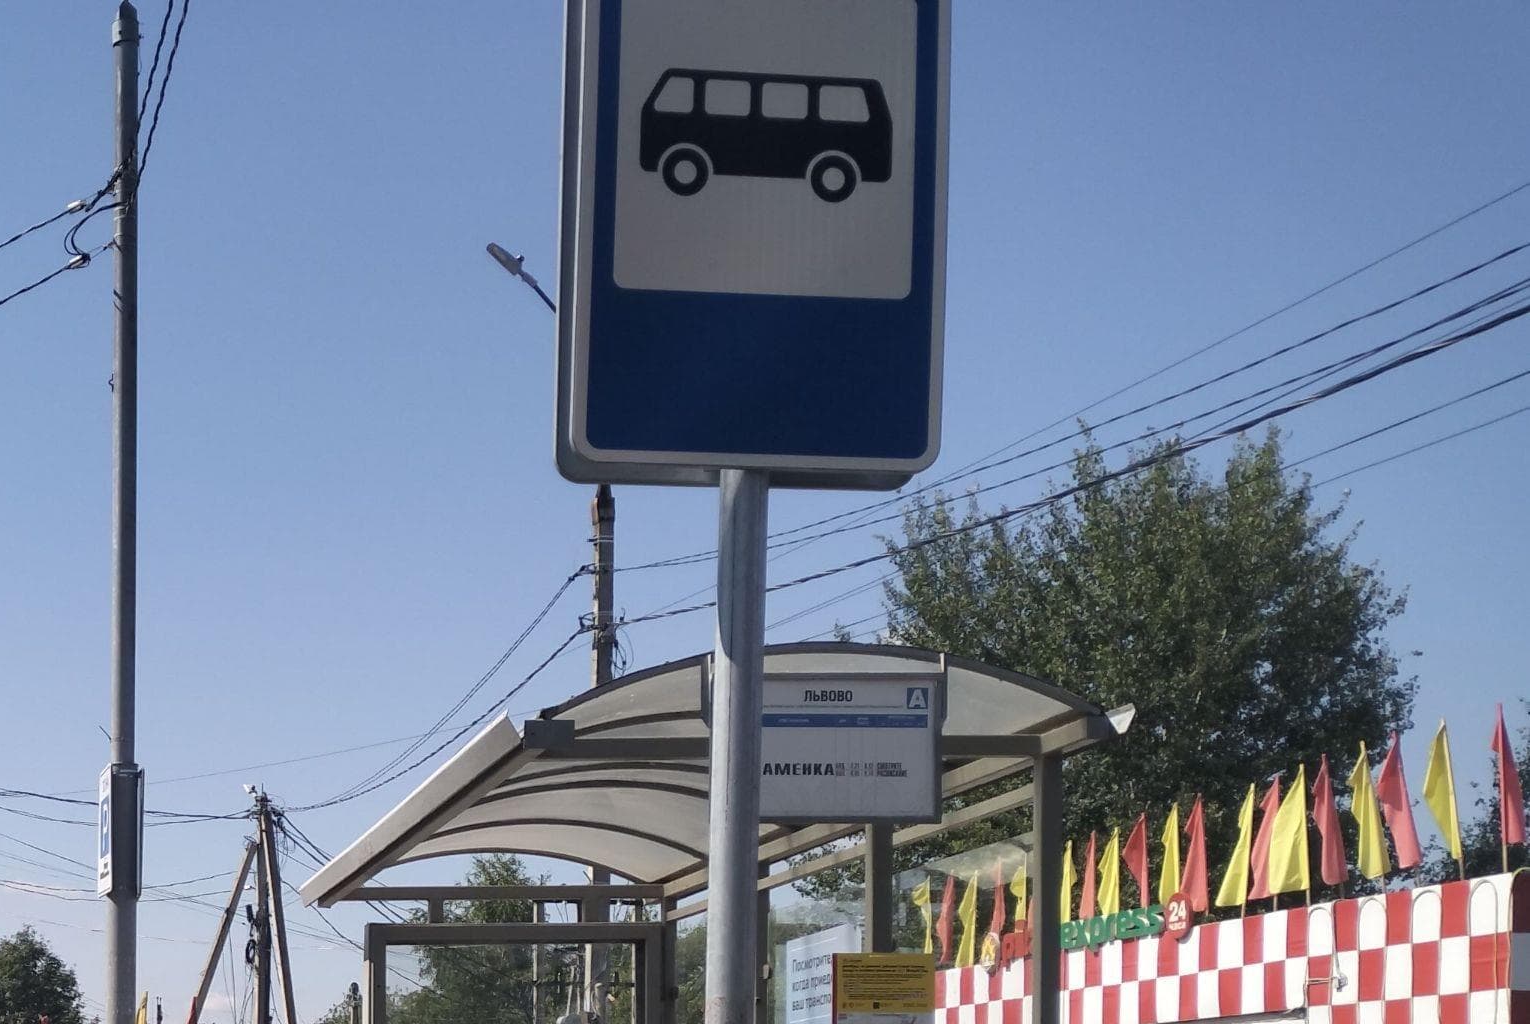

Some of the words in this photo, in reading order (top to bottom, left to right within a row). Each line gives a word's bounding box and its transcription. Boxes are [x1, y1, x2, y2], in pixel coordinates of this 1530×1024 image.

[804, 689, 853, 702] ЛЬВОВО
[762, 762, 835, 776] АМЕНКА
[1168, 900, 1187, 922] 24
[1061, 905, 1165, 953] express
[811, 974, 831, 990] приед
[792, 1000, 805, 1011] ваш
[806, 993, 831, 1009] транспо
